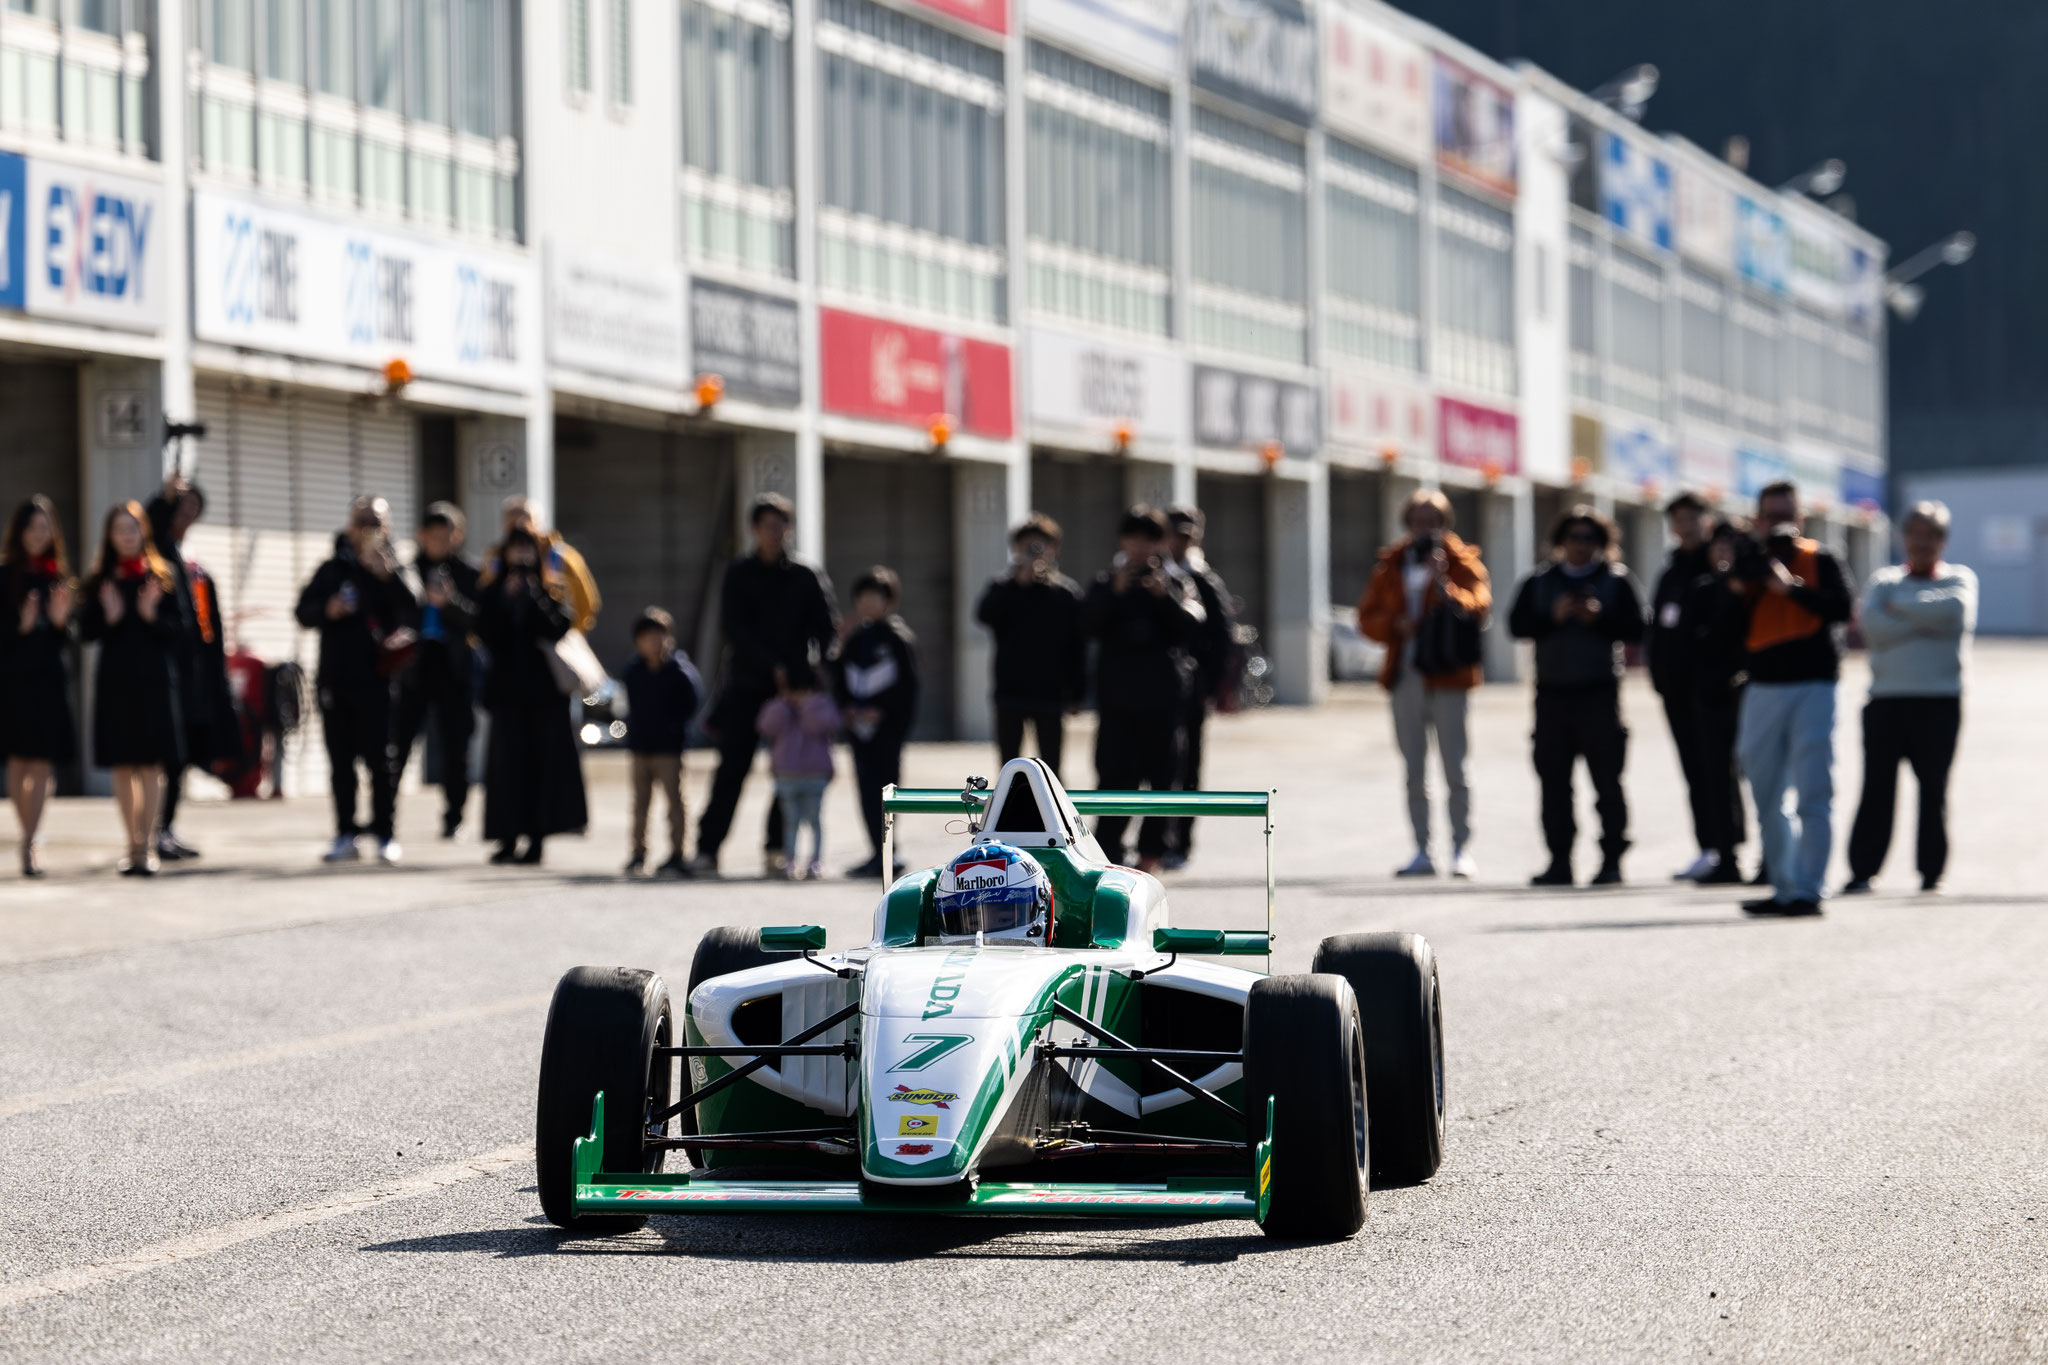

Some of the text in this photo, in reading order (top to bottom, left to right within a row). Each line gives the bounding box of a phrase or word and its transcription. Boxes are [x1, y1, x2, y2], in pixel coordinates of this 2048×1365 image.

[46, 181, 153, 303] EXEDY
[956, 875, 1004, 890] Marlboro
[886, 1033, 975, 1073] 7
[893, 1093, 955, 1101] SUNOCO
